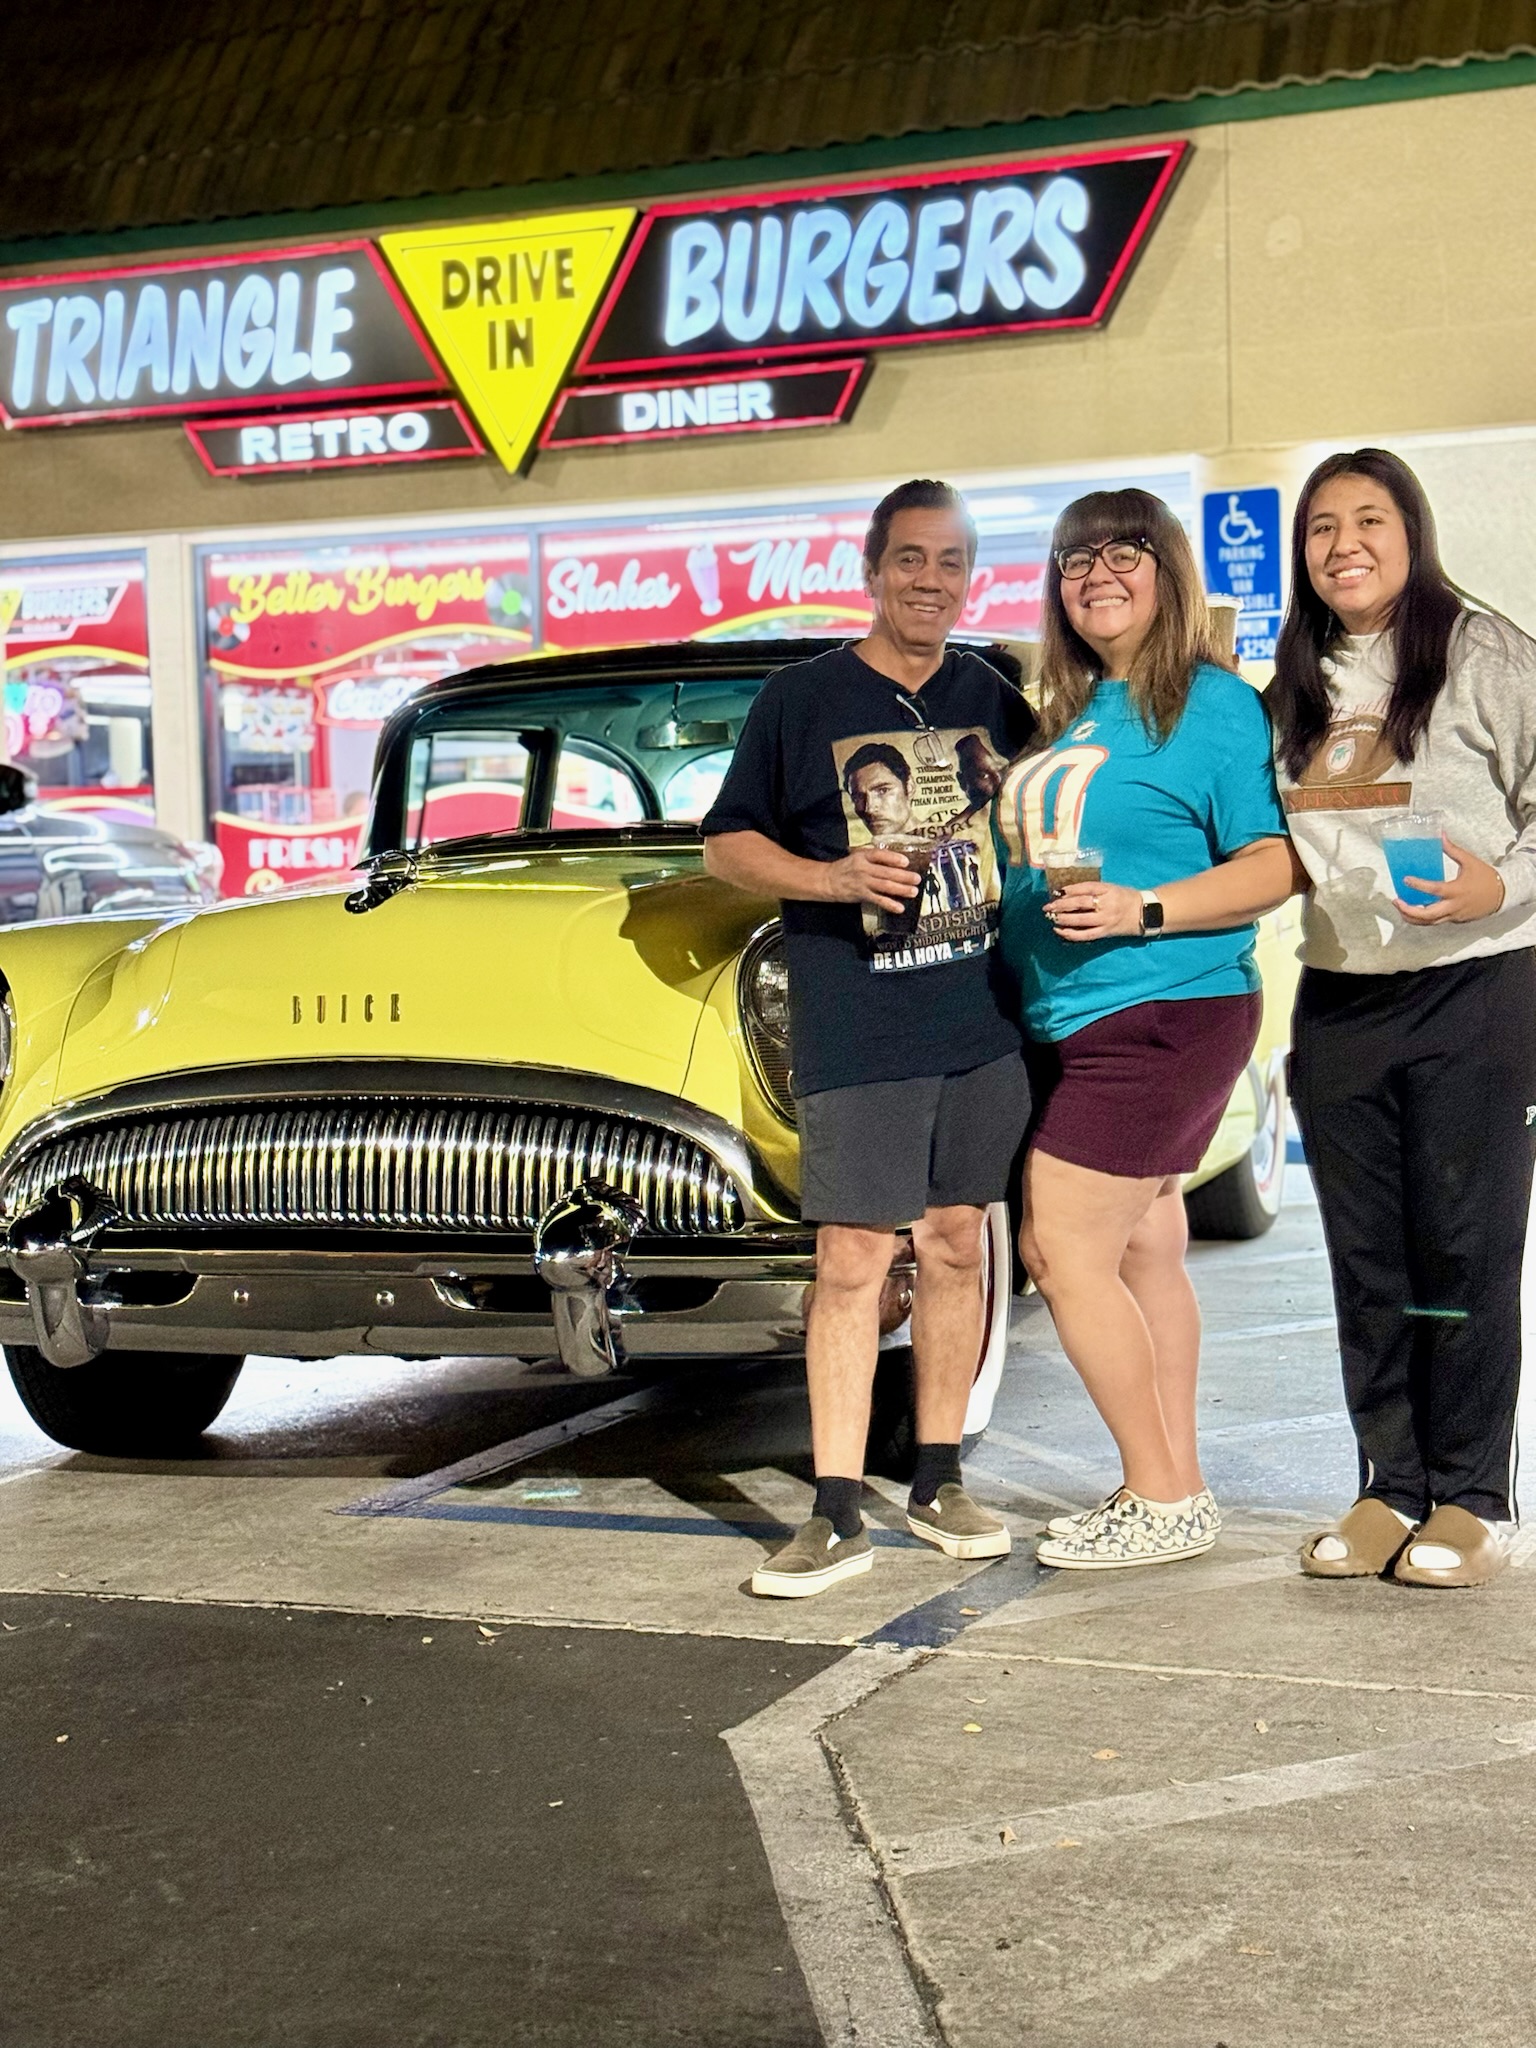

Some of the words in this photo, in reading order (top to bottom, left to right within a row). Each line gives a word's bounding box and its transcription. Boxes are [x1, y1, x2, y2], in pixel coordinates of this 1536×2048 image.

[441, 248, 575, 310] DRIVE
[663, 176, 1089, 346] BURGERS
[7, 267, 355, 409] TRIANGLE
[488, 316, 535, 370] IN
[621, 381, 773, 432] DINER
[240, 412, 429, 465] RETRO
[228, 572, 345, 624] Better
[344, 557, 490, 622] Burgers
[547, 557, 681, 620] Shakes
[729, 539, 865, 604] Malt
[1242, 638, 1276, 660] $250
[249, 838, 356, 869] FRESH
[874, 952, 893, 970] DE
[895, 949, 914, 968] LA
[915, 942, 953, 966] HOYA
[292, 993, 401, 1024] BUICK
